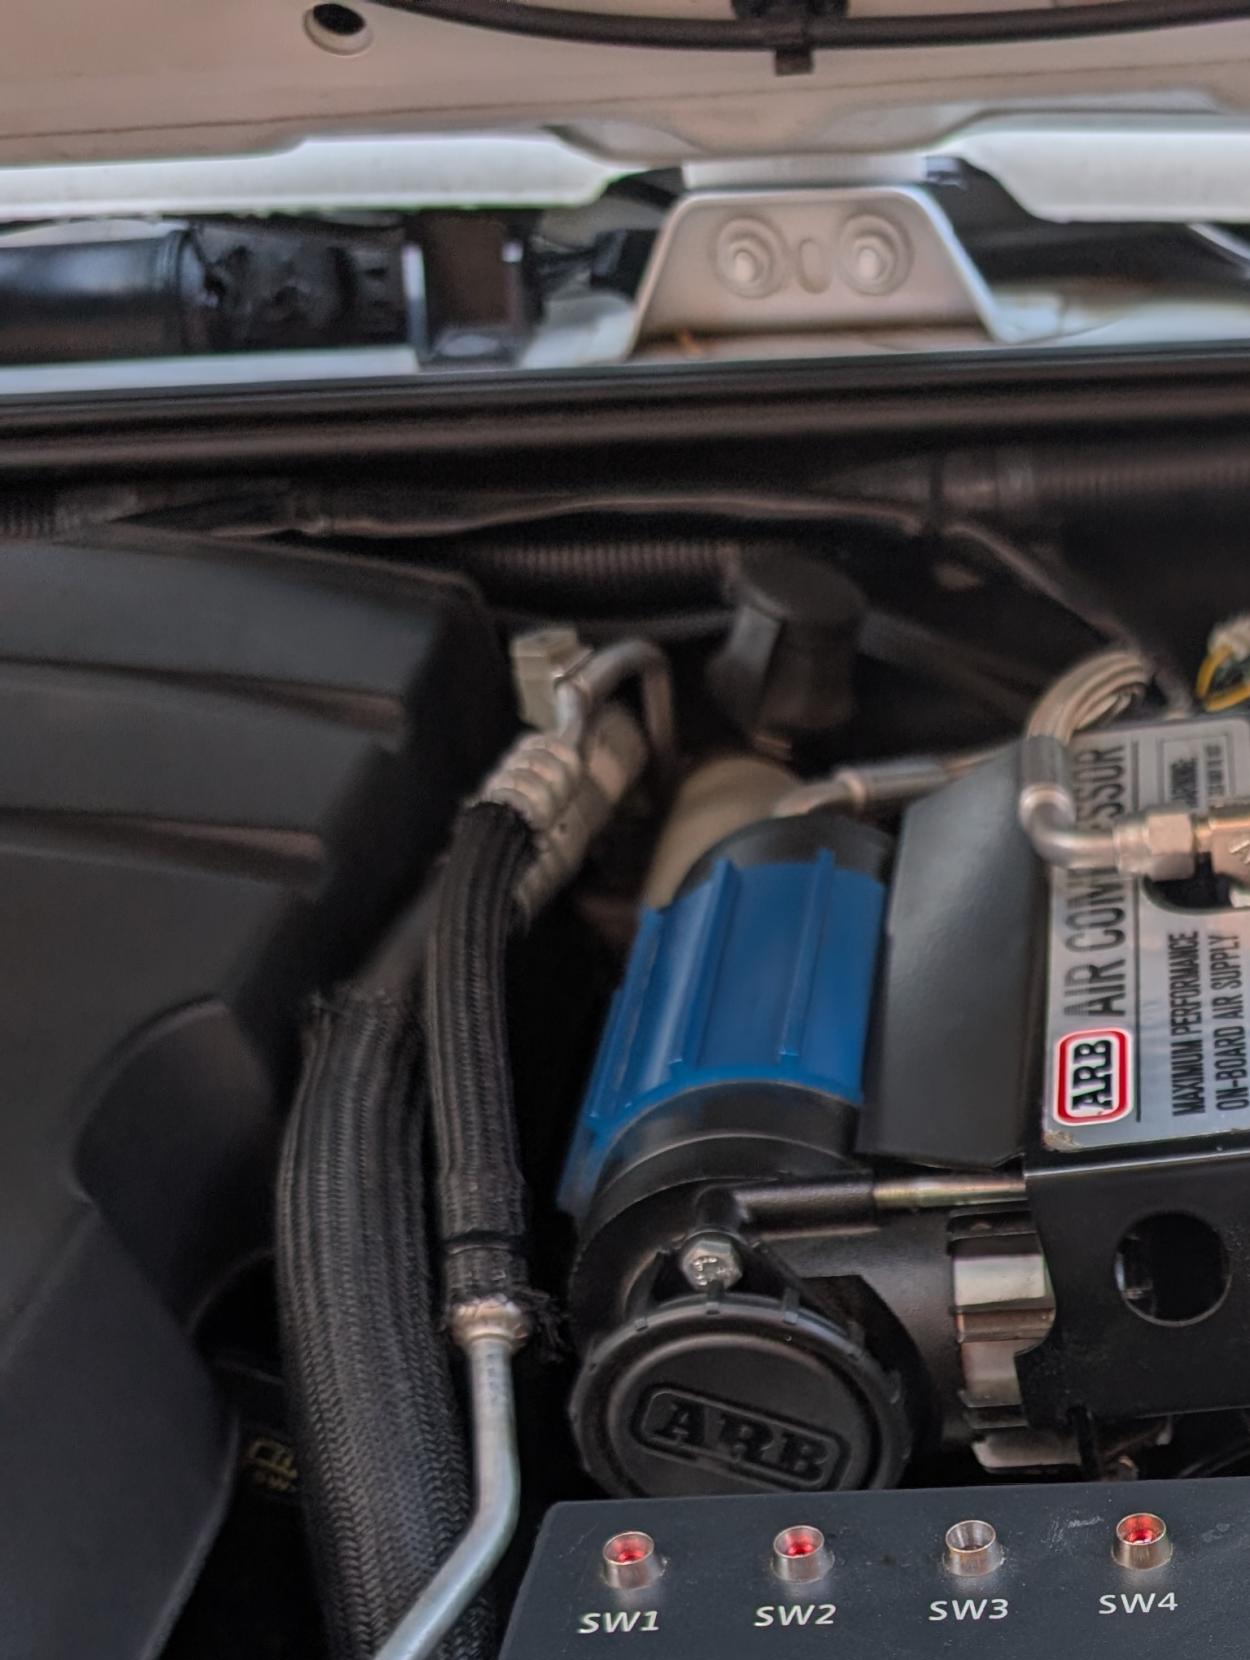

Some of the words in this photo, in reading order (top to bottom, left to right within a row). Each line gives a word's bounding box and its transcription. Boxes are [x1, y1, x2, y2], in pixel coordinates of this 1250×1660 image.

[1065, 746, 1125, 952] COMSSOR
[1064, 958, 1125, 1018] AIR
[1167, 931, 1203, 1035] PERFORMANCE
[1208, 934, 1241, 989] SUPPLY
[1210, 994, 1244, 1020] AIR
[1072, 1040, 1113, 1110] ARB
[1170, 1039, 1206, 1117] MAXIMUM
[1213, 1025, 1249, 1112] ON-BOARD
[650, 1399, 828, 1484] ARB
[577, 1610, 660, 1634] SW1
[753, 1603, 837, 1627] SW2
[928, 1598, 1009, 1621] SW3
[1098, 1591, 1179, 1614] SW4
